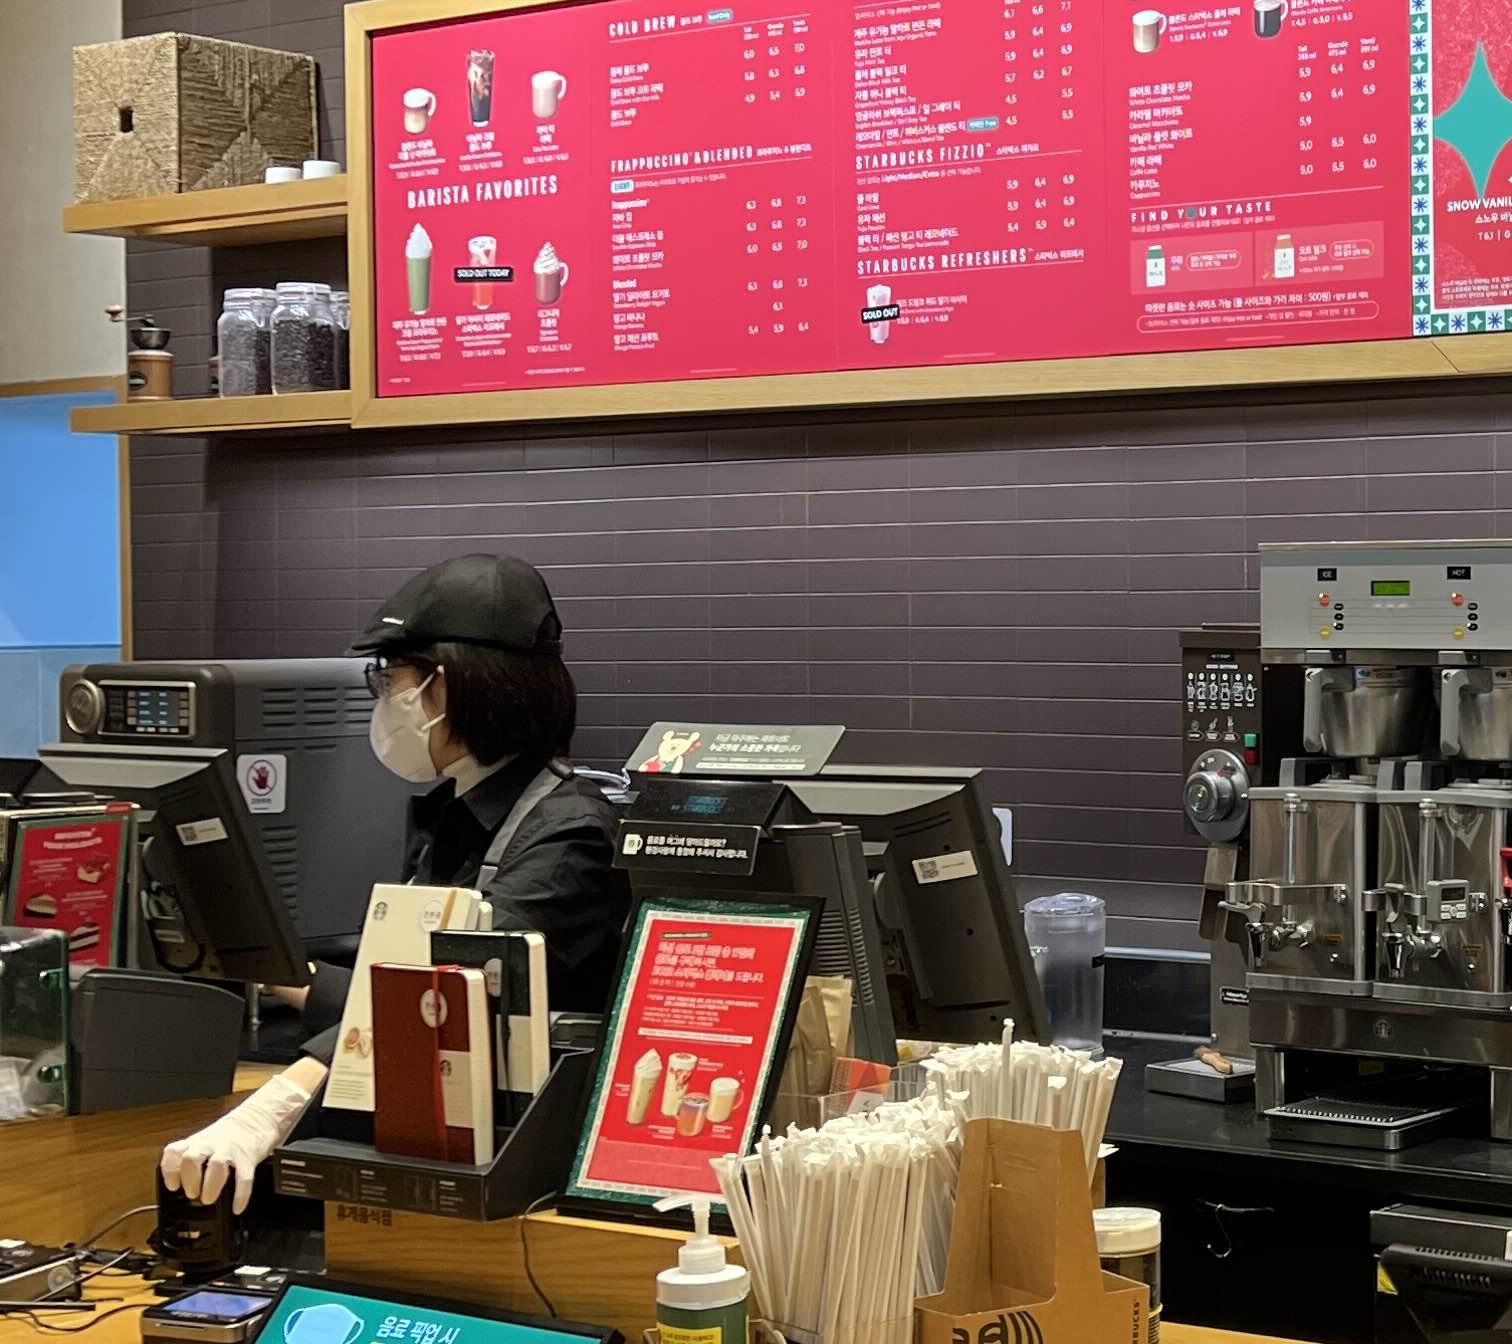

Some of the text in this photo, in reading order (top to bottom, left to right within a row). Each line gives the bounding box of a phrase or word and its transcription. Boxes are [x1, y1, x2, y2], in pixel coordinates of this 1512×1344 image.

[609, 15, 675, 36] COLD BREW
[703, 145, 753, 163] BLENDED
[856, 149, 933, 170] STARBUCKS
[940, 144, 985, 161] FIZZIO
[408, 175, 557, 208] BARISTA FAVORITES
[1131, 210, 1168, 223] FIND
[1226, 202, 1272, 215] TASTE
[1447, 199, 1481, 212] SNOW
[857, 248, 1028, 275] STARBUCKS REFRESHERS
[863, 310, 882, 320] SOLD
[377, 1316, 410, 1338] 음료
